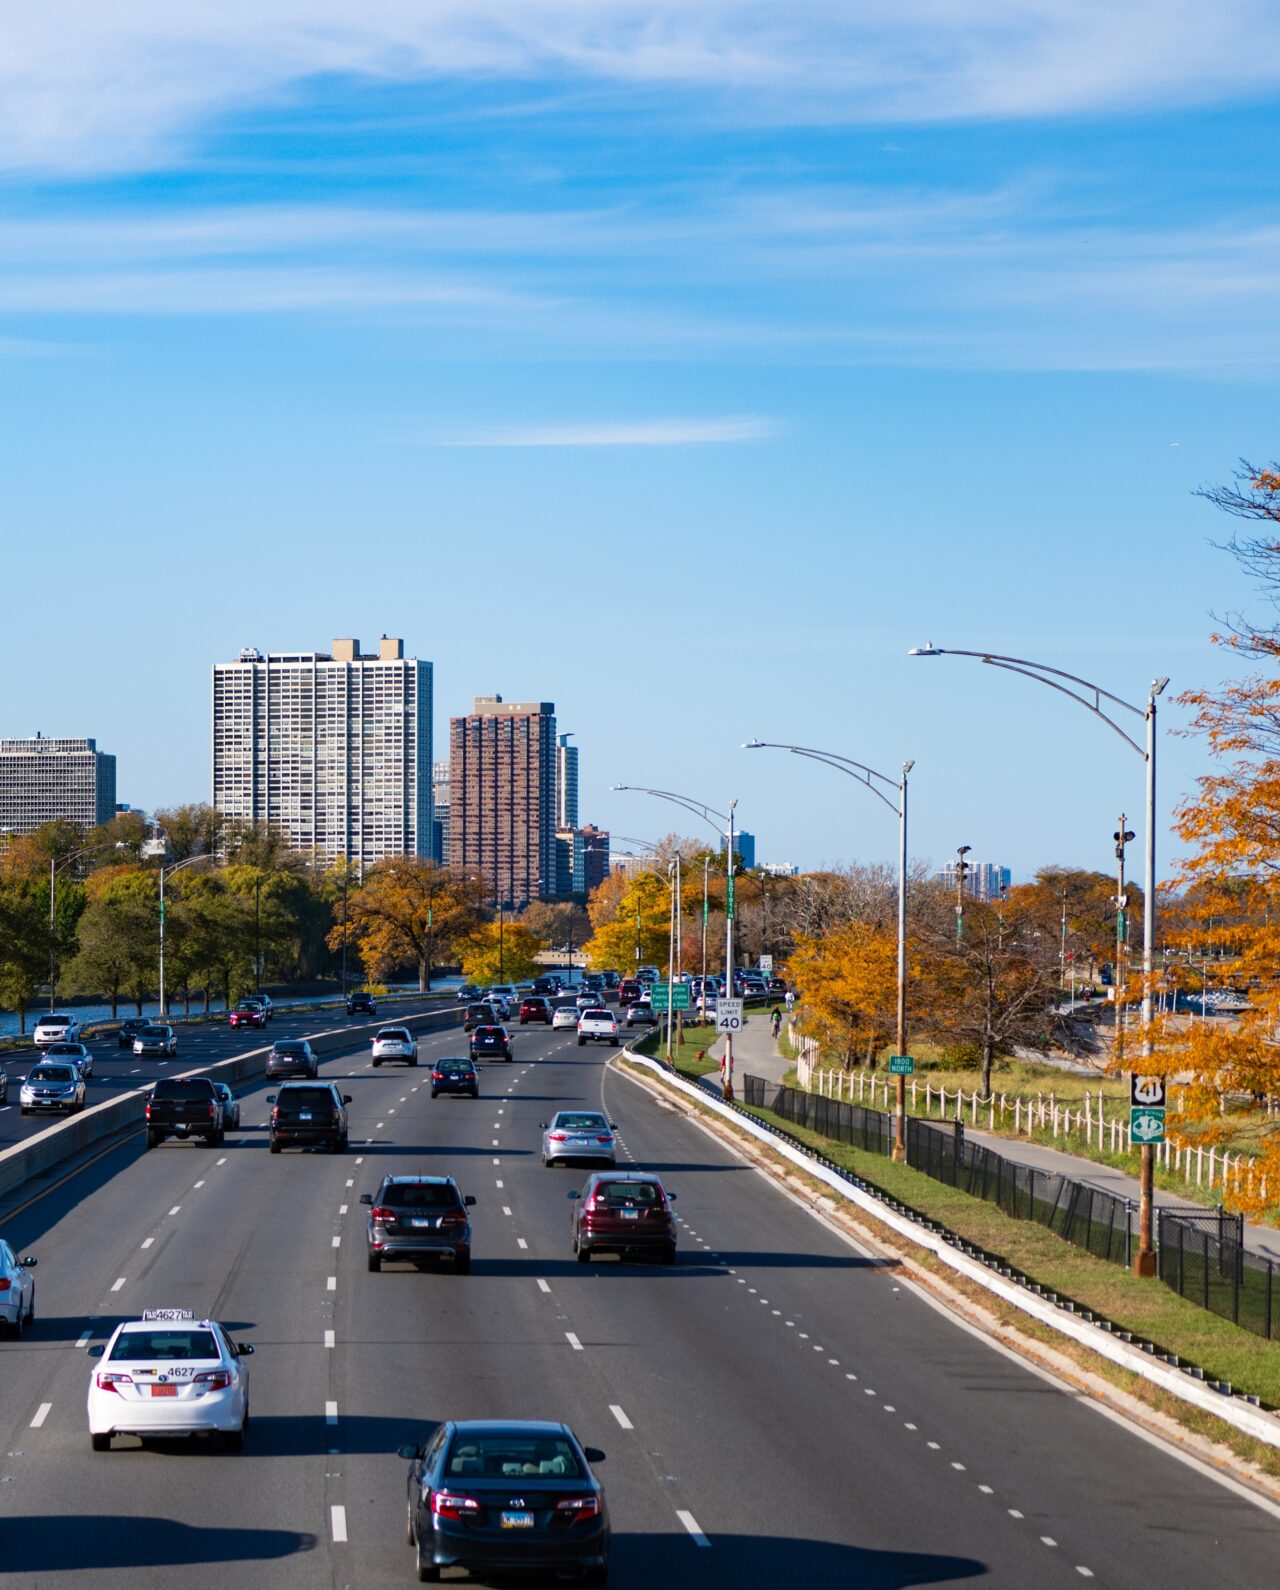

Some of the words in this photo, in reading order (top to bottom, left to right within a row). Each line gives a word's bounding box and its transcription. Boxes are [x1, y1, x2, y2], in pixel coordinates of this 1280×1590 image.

[720, 1017, 740, 1029] 40
[1139, 1082, 1156, 1097] 41
[157, 1310, 181, 1320] 4627
[168, 1367, 195, 1376] 4627
